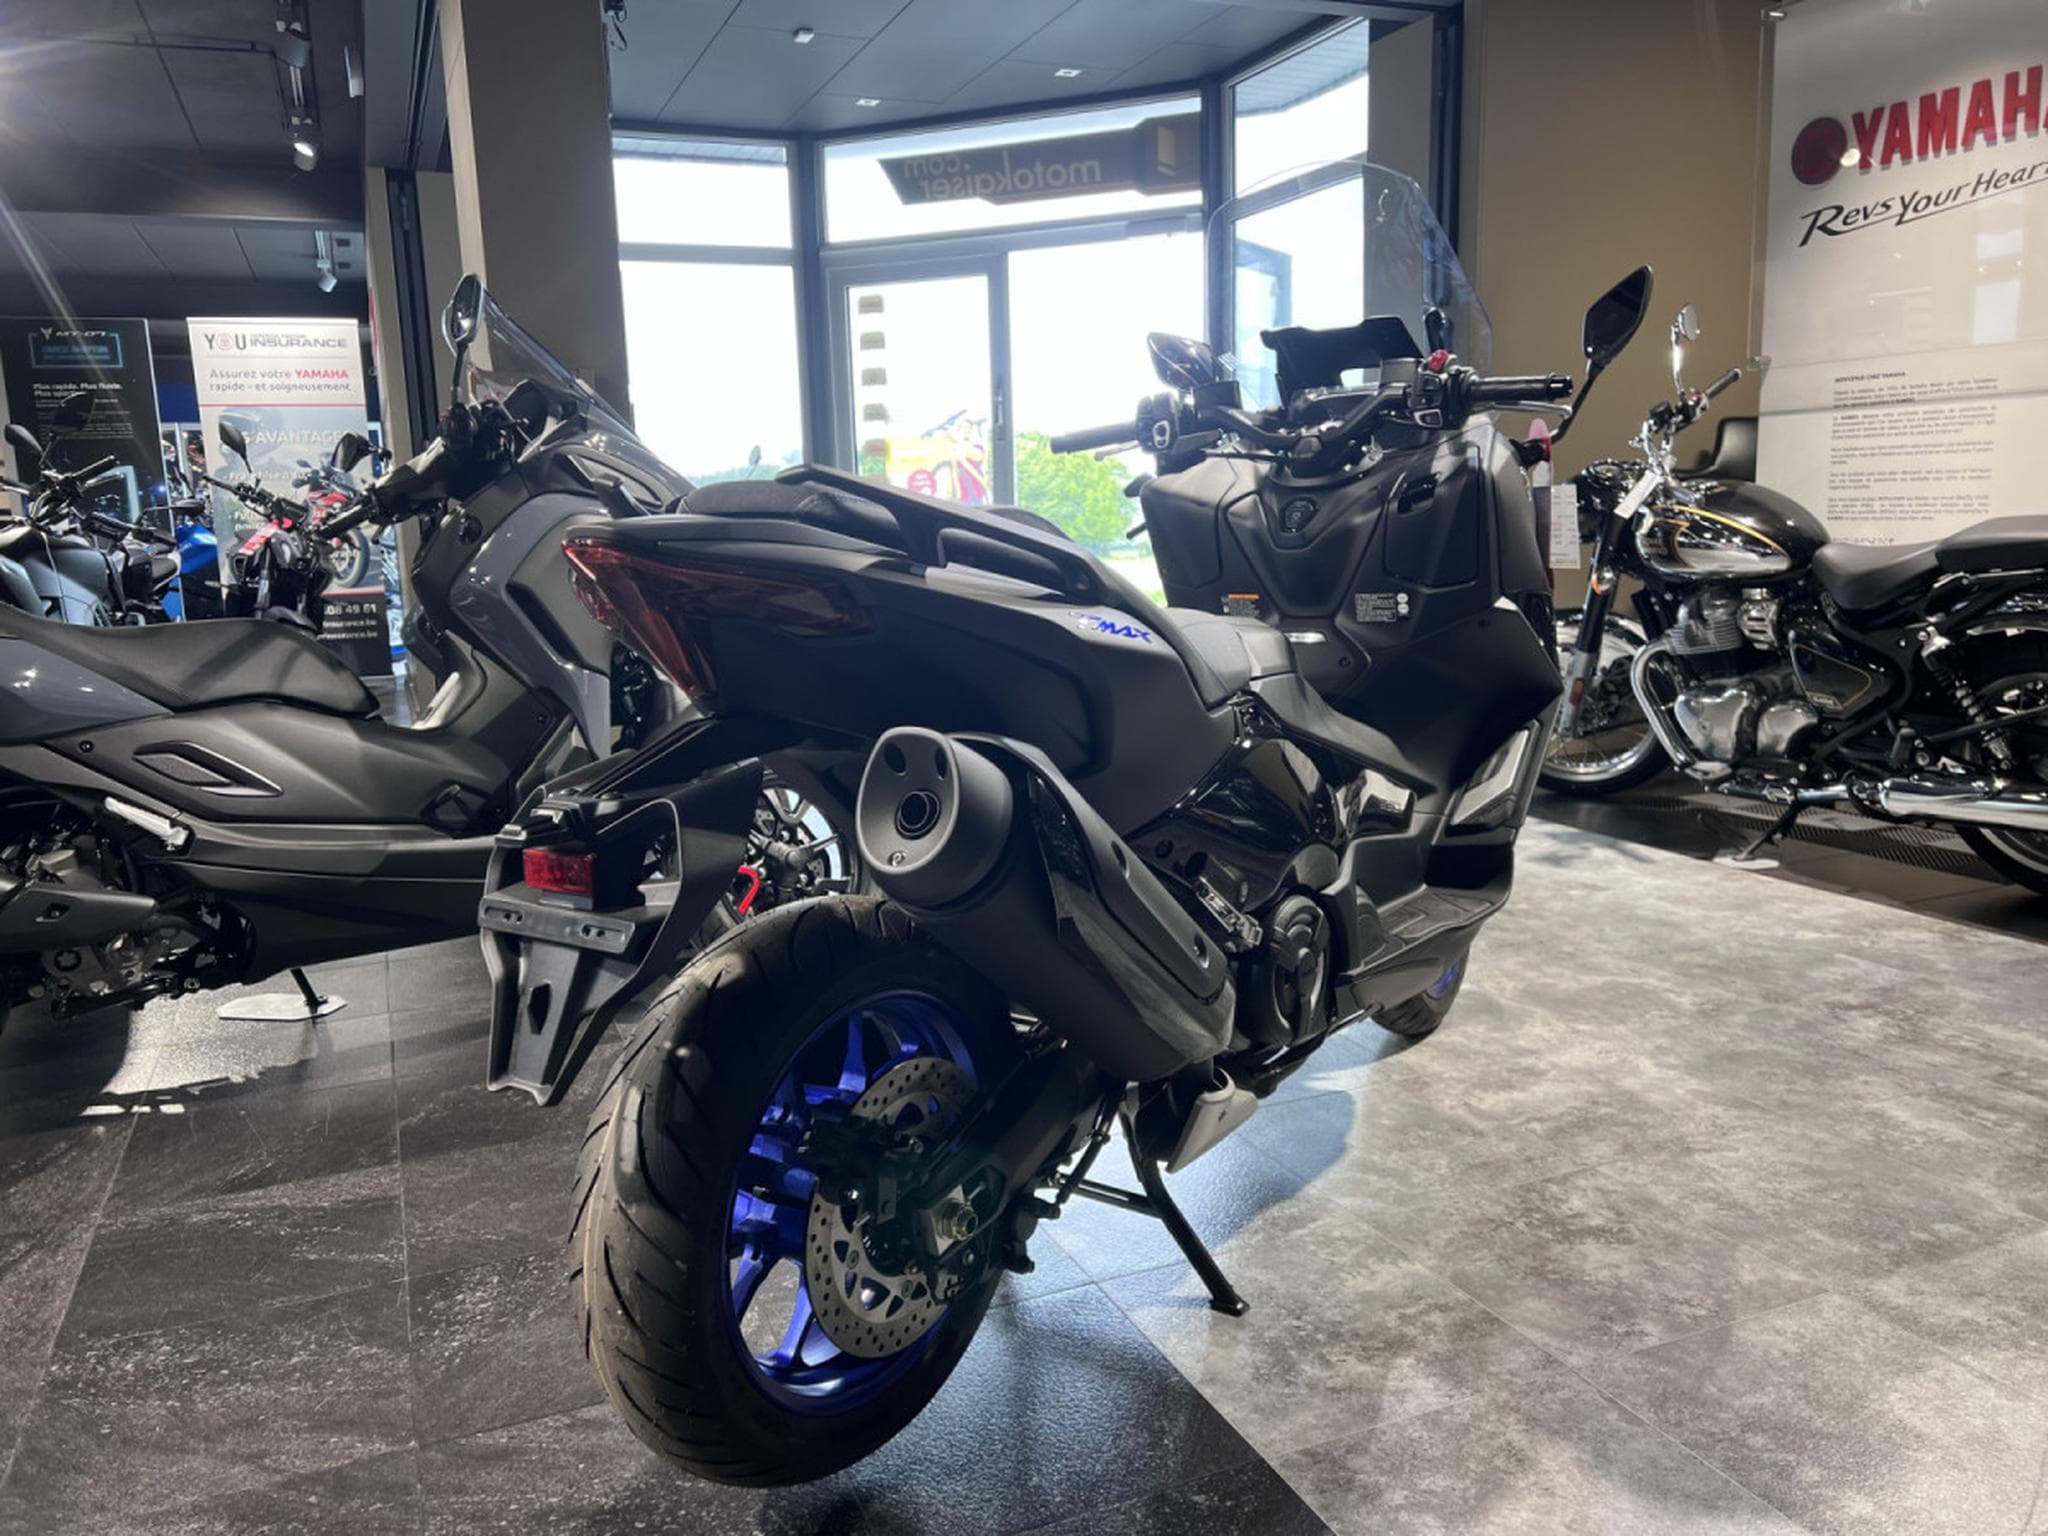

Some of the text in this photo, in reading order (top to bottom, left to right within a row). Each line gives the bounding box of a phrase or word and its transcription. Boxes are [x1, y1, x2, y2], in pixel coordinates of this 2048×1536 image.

[1852, 65, 2048, 171] YAMAH
[1971, 161, 2048, 198] Hear
[250, 339, 348, 348] INSURANCE
[209, 369, 349, 379] Assurez votre YAMAHA
[210, 382, 246, 392] rapide
[255, 382, 267, 391] et
[269, 382, 351, 393] soigneusement
[255, 431, 350, 443] AVANTAGE
